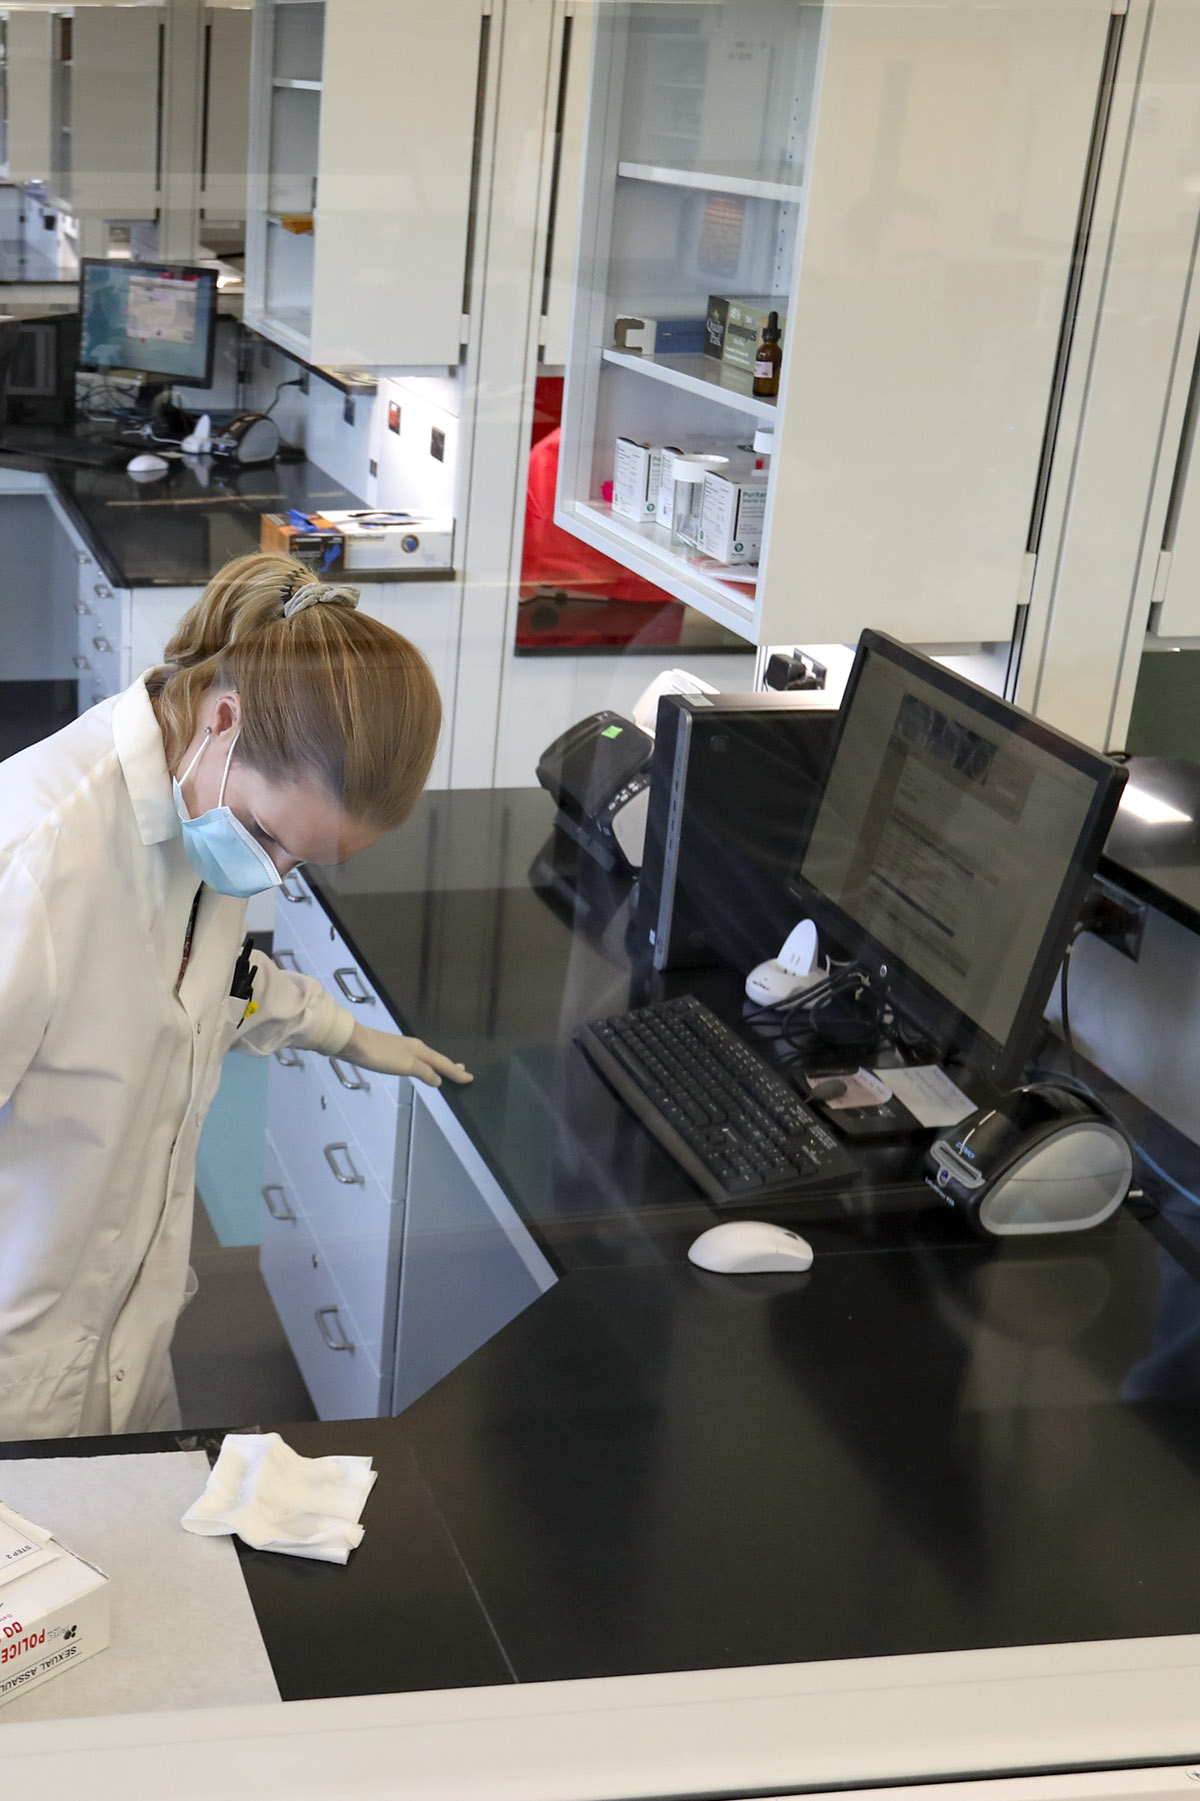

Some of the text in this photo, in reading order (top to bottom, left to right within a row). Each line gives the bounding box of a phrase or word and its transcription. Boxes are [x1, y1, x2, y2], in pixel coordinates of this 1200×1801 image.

[13, 1545, 32, 1557] STEP
[2, 1621, 23, 1639] DO
[1, 1628, 46, 1664] POLICE
[40, 1645, 77, 1671] SEXUAL
